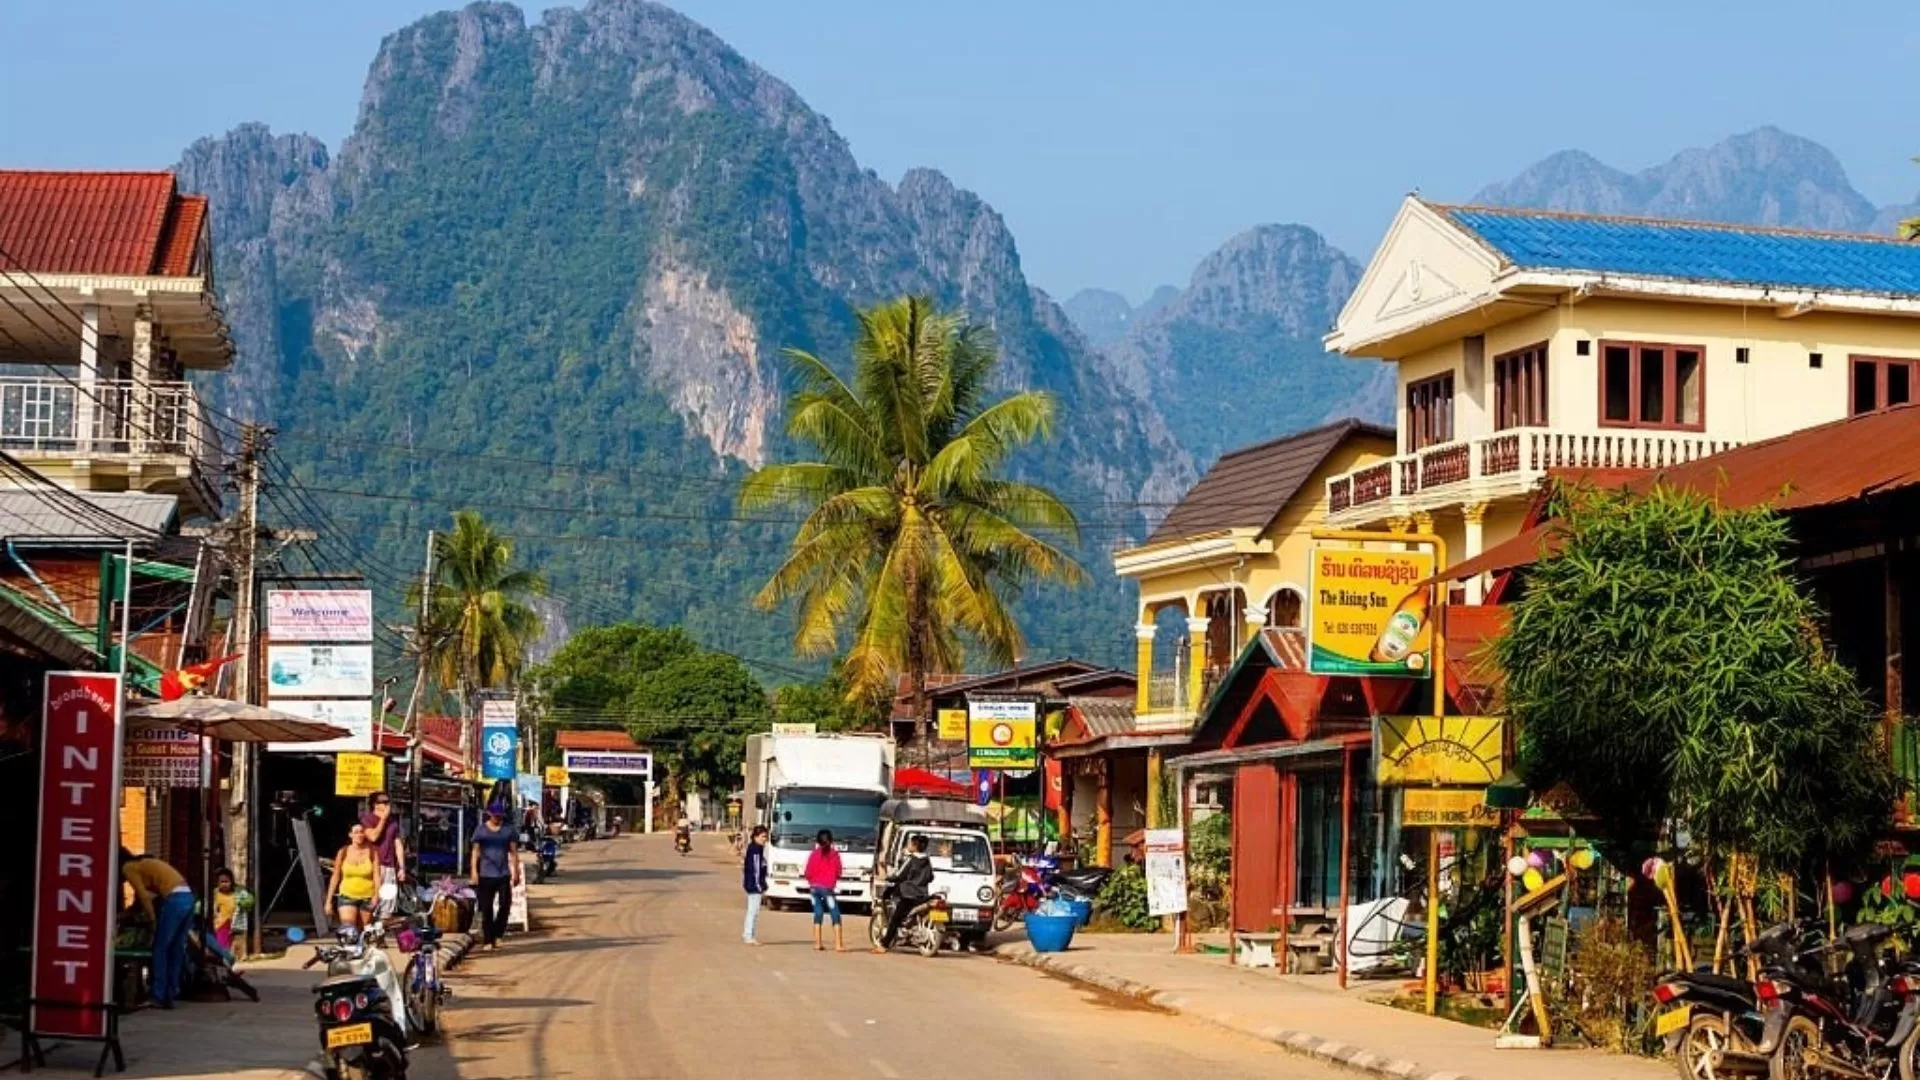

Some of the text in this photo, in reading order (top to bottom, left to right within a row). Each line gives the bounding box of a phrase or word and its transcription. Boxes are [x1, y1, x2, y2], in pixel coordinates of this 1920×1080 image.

[1320, 589, 1388, 610] The Rising Sun
[291, 606, 349, 617] Welcome
[50, 685, 111, 713] broadband
[136, 744, 167, 754] Guest
[53, 711, 99, 985] INTERNET
